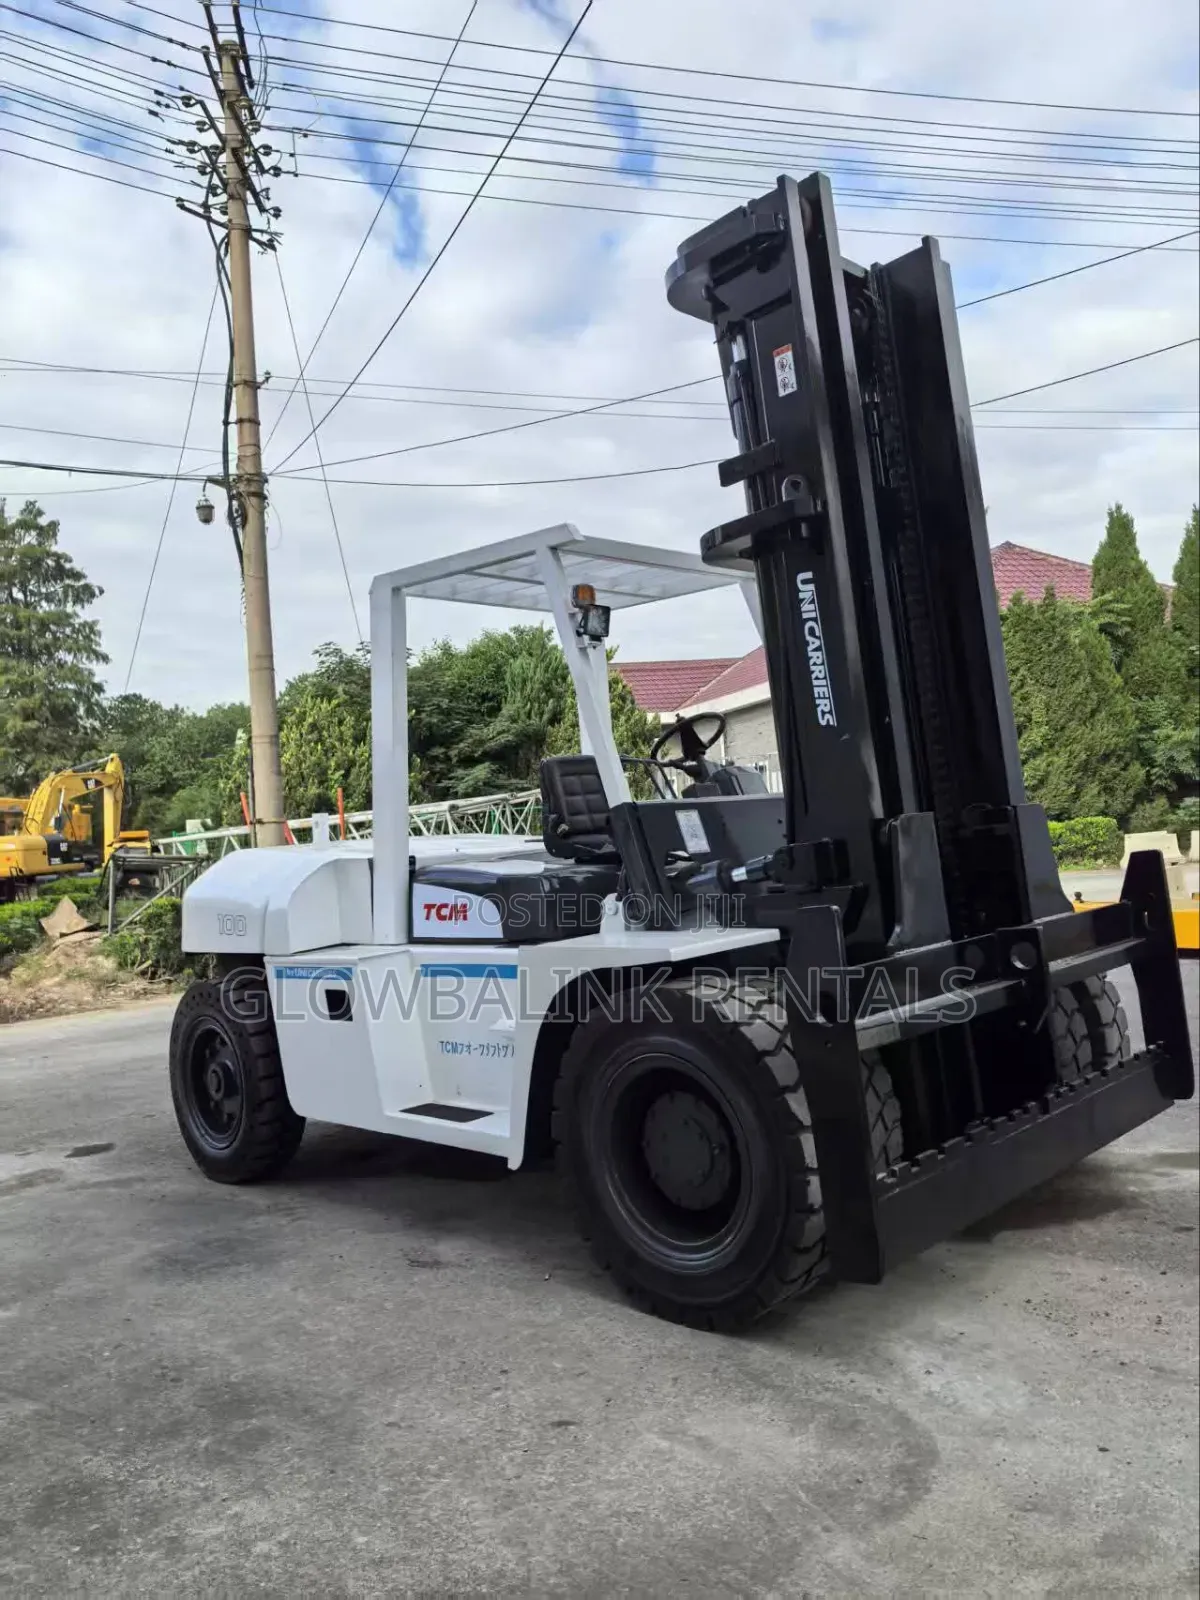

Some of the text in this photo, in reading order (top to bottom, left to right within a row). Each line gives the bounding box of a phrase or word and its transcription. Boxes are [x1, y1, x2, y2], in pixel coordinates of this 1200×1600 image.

[796, 570, 835, 726] UNICARRIERS
[423, 903, 468, 921] TCM
[217, 913, 247, 937] 100
